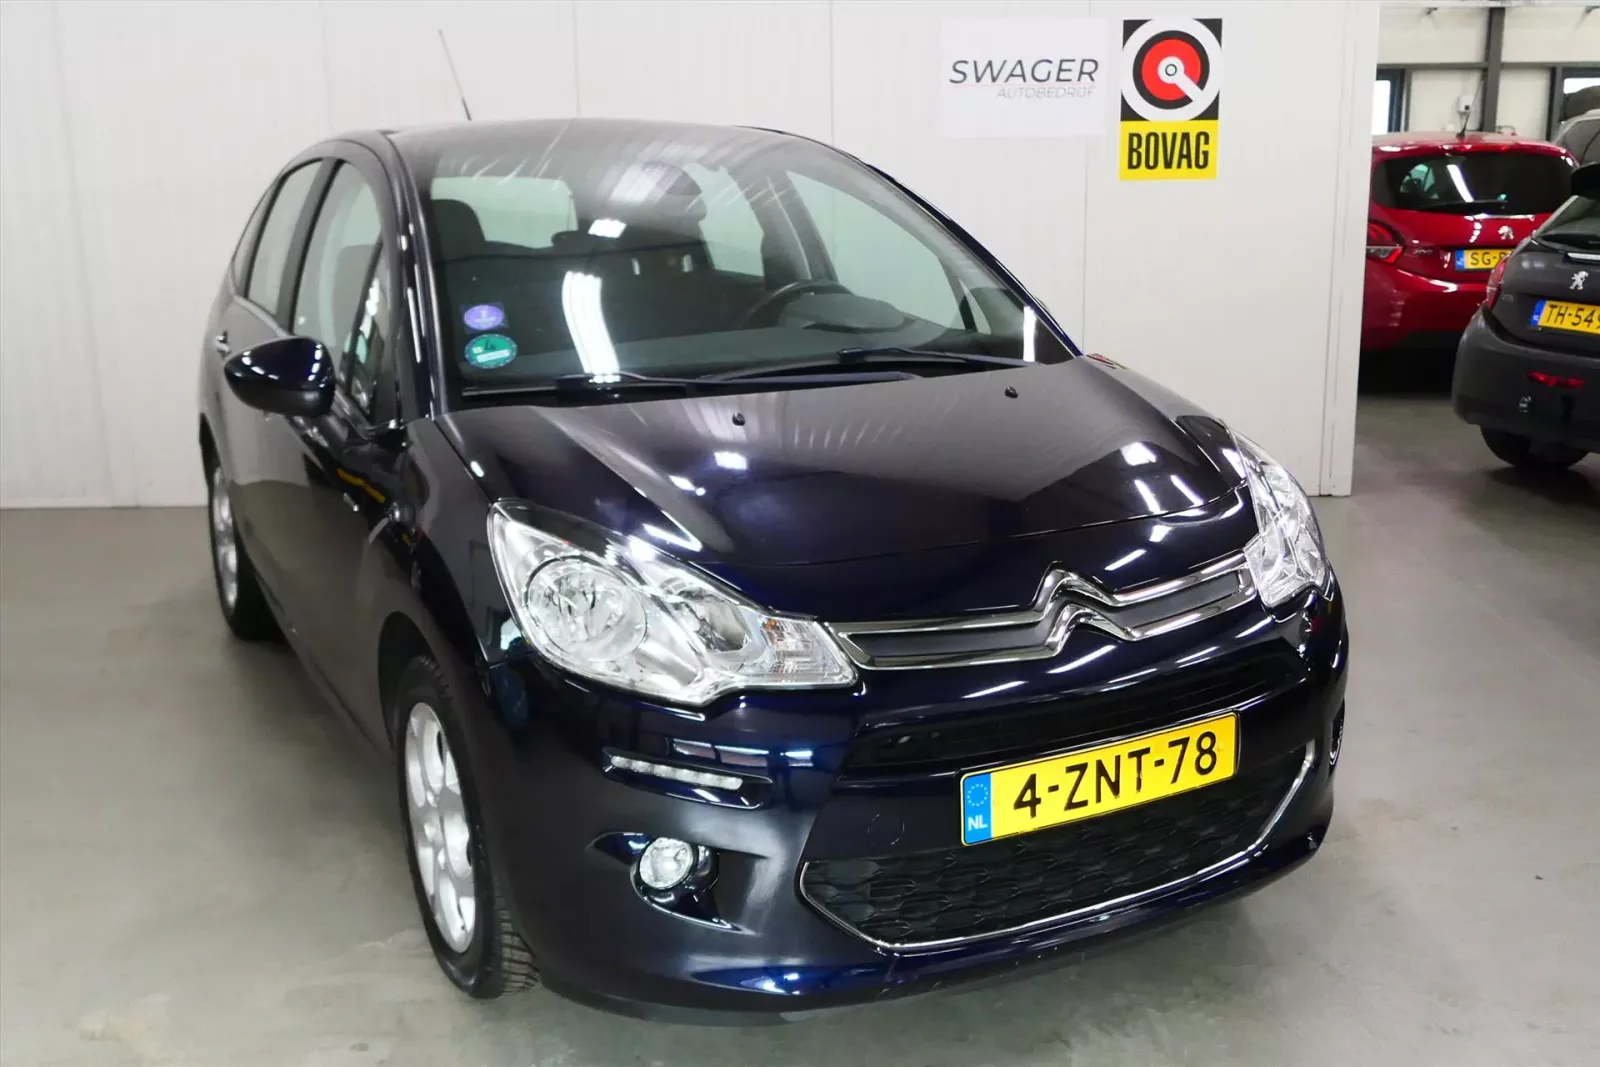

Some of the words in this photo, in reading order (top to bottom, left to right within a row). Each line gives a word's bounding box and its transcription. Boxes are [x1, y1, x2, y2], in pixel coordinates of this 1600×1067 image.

[949, 59, 1098, 84] SWAGER
[1127, 131, 1210, 170] BOVAG
[1013, 730, 1217, 818] 4-ZNT-78
[968, 814, 988, 831] NL
